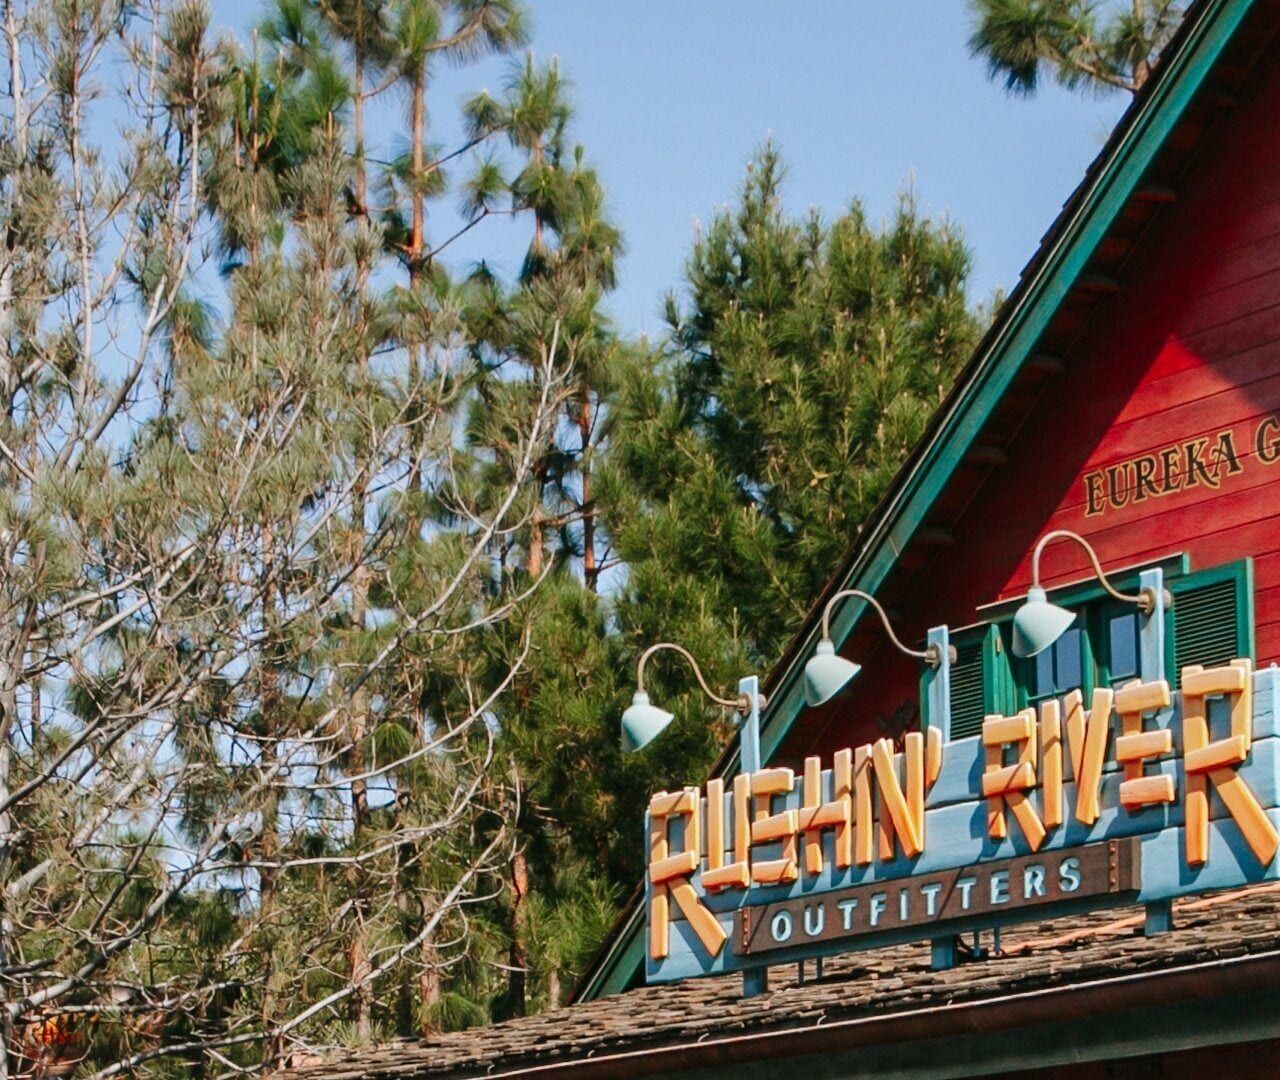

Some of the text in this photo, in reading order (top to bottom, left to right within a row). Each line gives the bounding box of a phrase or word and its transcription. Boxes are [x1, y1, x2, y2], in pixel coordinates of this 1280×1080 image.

[1083, 431, 1242, 518] EUREKA
[981, 657, 1280, 867] RIVER
[770, 855, 1082, 944] OUTFITTERS
